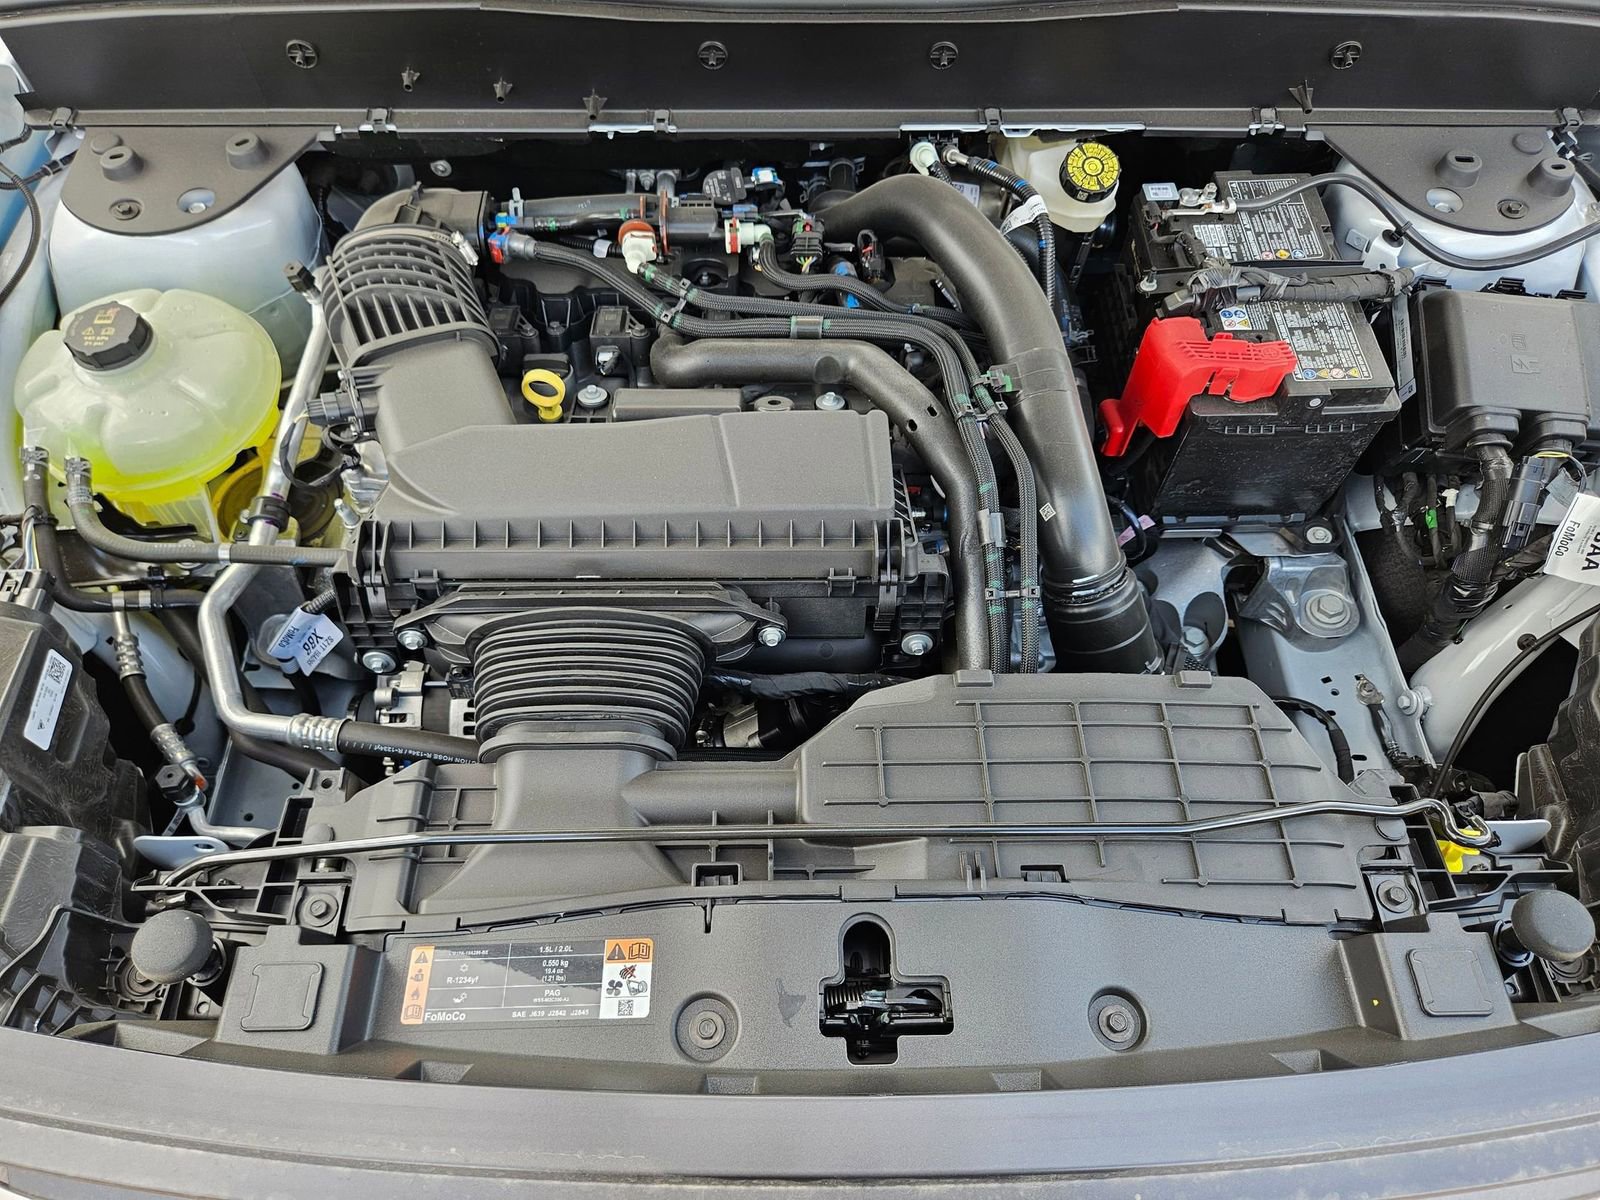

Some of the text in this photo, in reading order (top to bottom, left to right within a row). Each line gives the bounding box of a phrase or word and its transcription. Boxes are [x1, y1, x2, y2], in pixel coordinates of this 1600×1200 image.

[1555, 520, 1581, 557] FoMoCo
[374, 744, 404, 754] R-1234yf
[433, 753, 454, 762] HOSE
[559, 944, 573, 952] 2.0L
[542, 959, 569, 968] 0.550 kg
[446, 975, 479, 985] R-1234yf
[544, 989, 561, 997] PAG
[424, 1011, 467, 1021] FoMoCo
[547, 1009, 567, 1017] J2842
